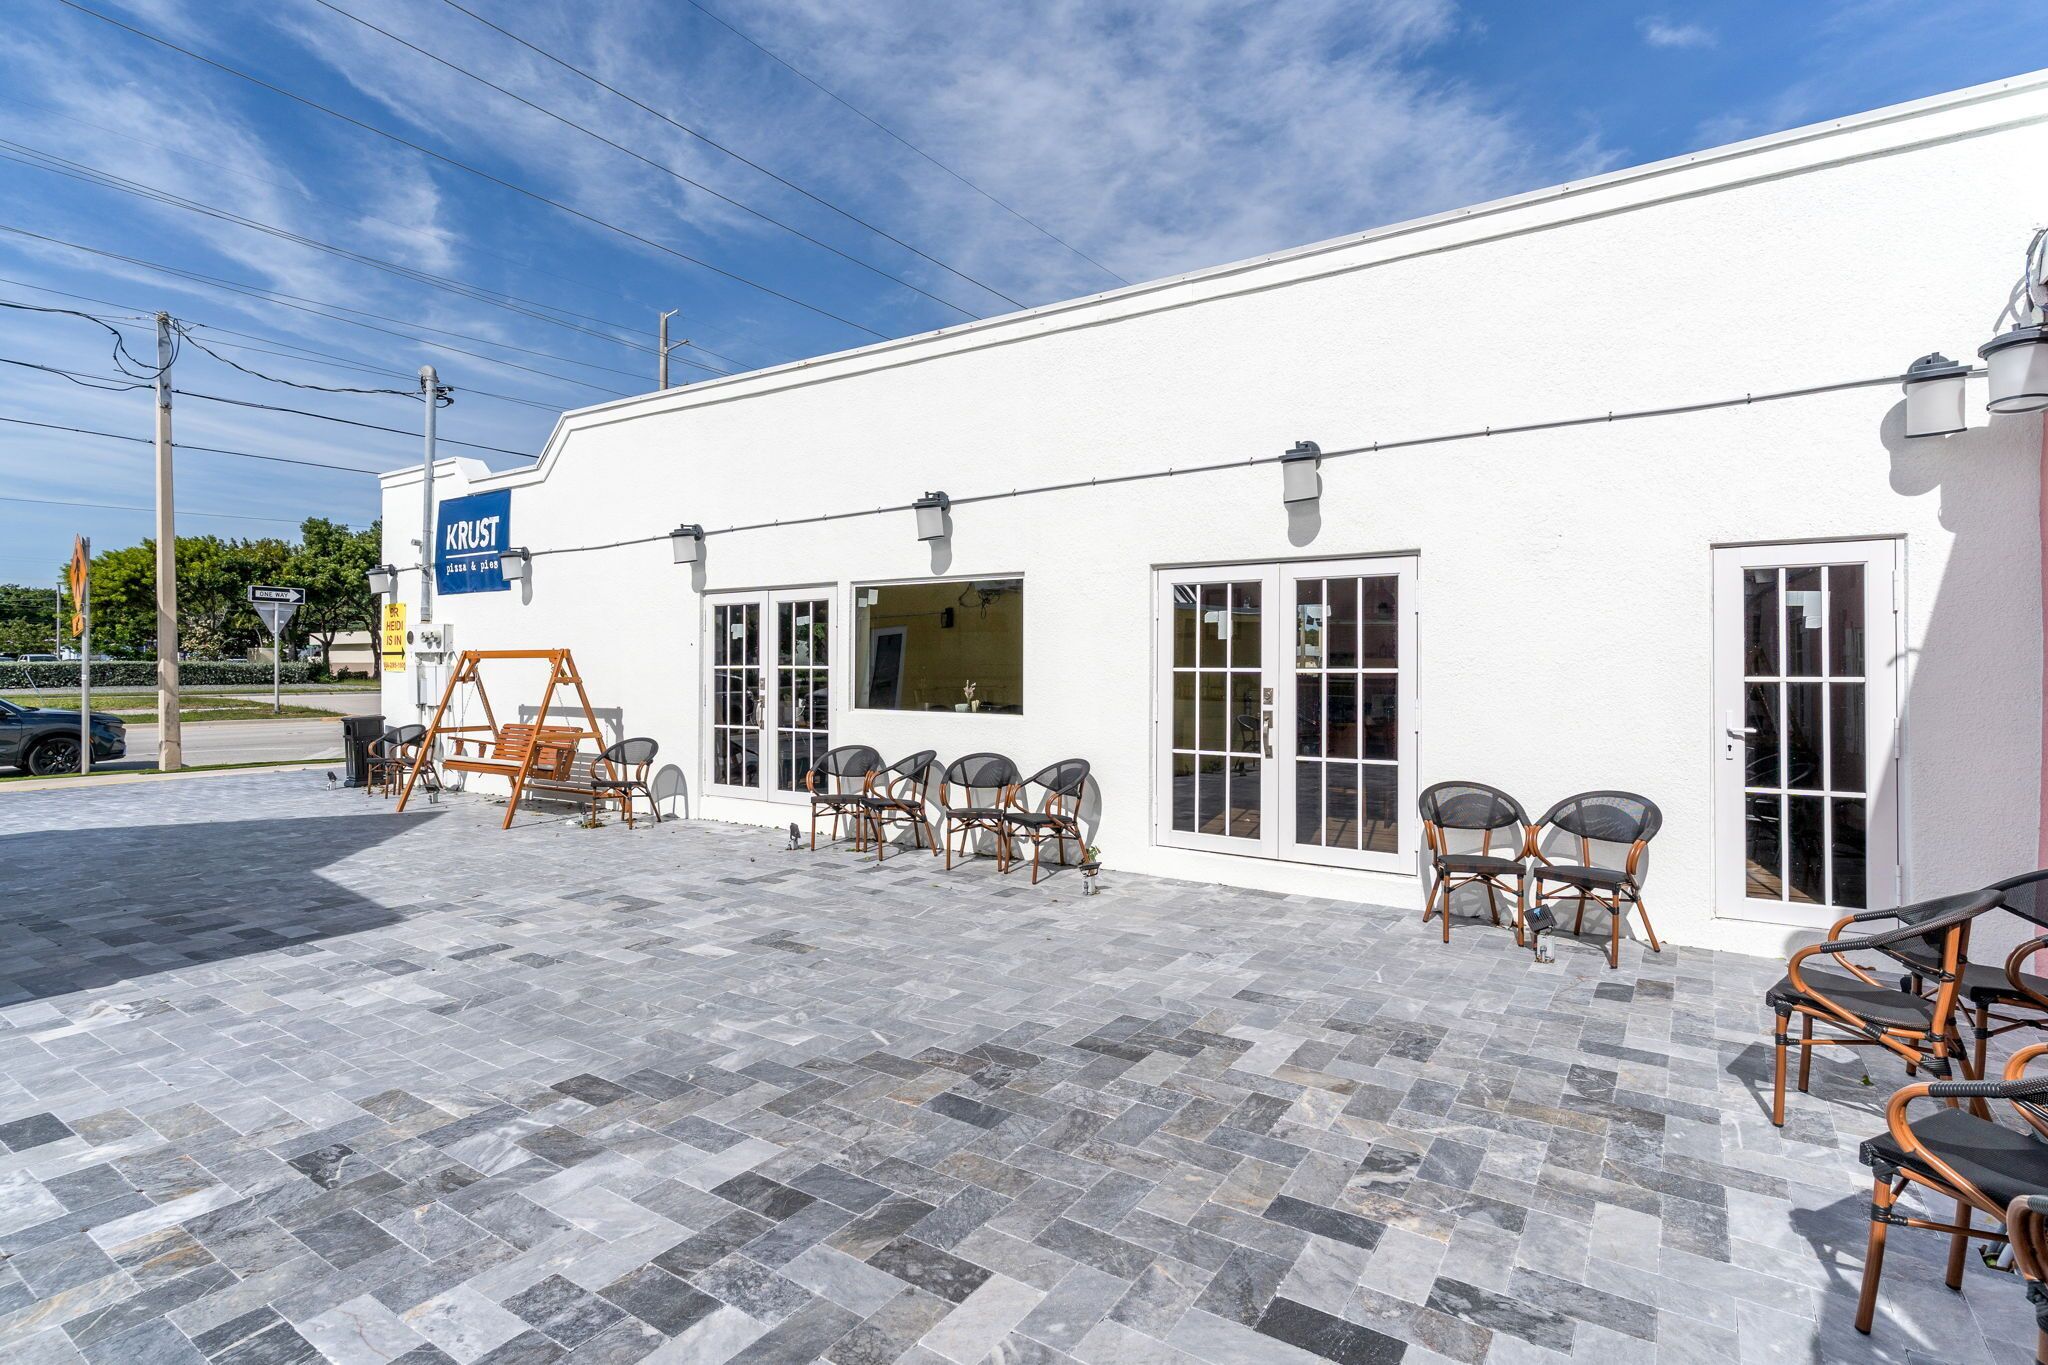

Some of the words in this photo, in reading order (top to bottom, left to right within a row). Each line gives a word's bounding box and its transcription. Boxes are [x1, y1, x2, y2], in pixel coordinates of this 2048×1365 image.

[446, 516, 500, 550] KRUST
[471, 561, 477, 571] &
[480, 560, 499, 573] pies
[386, 620, 404, 631] HEIDI
[386, 635, 393, 646] IS
[395, 635, 402, 646] IN
